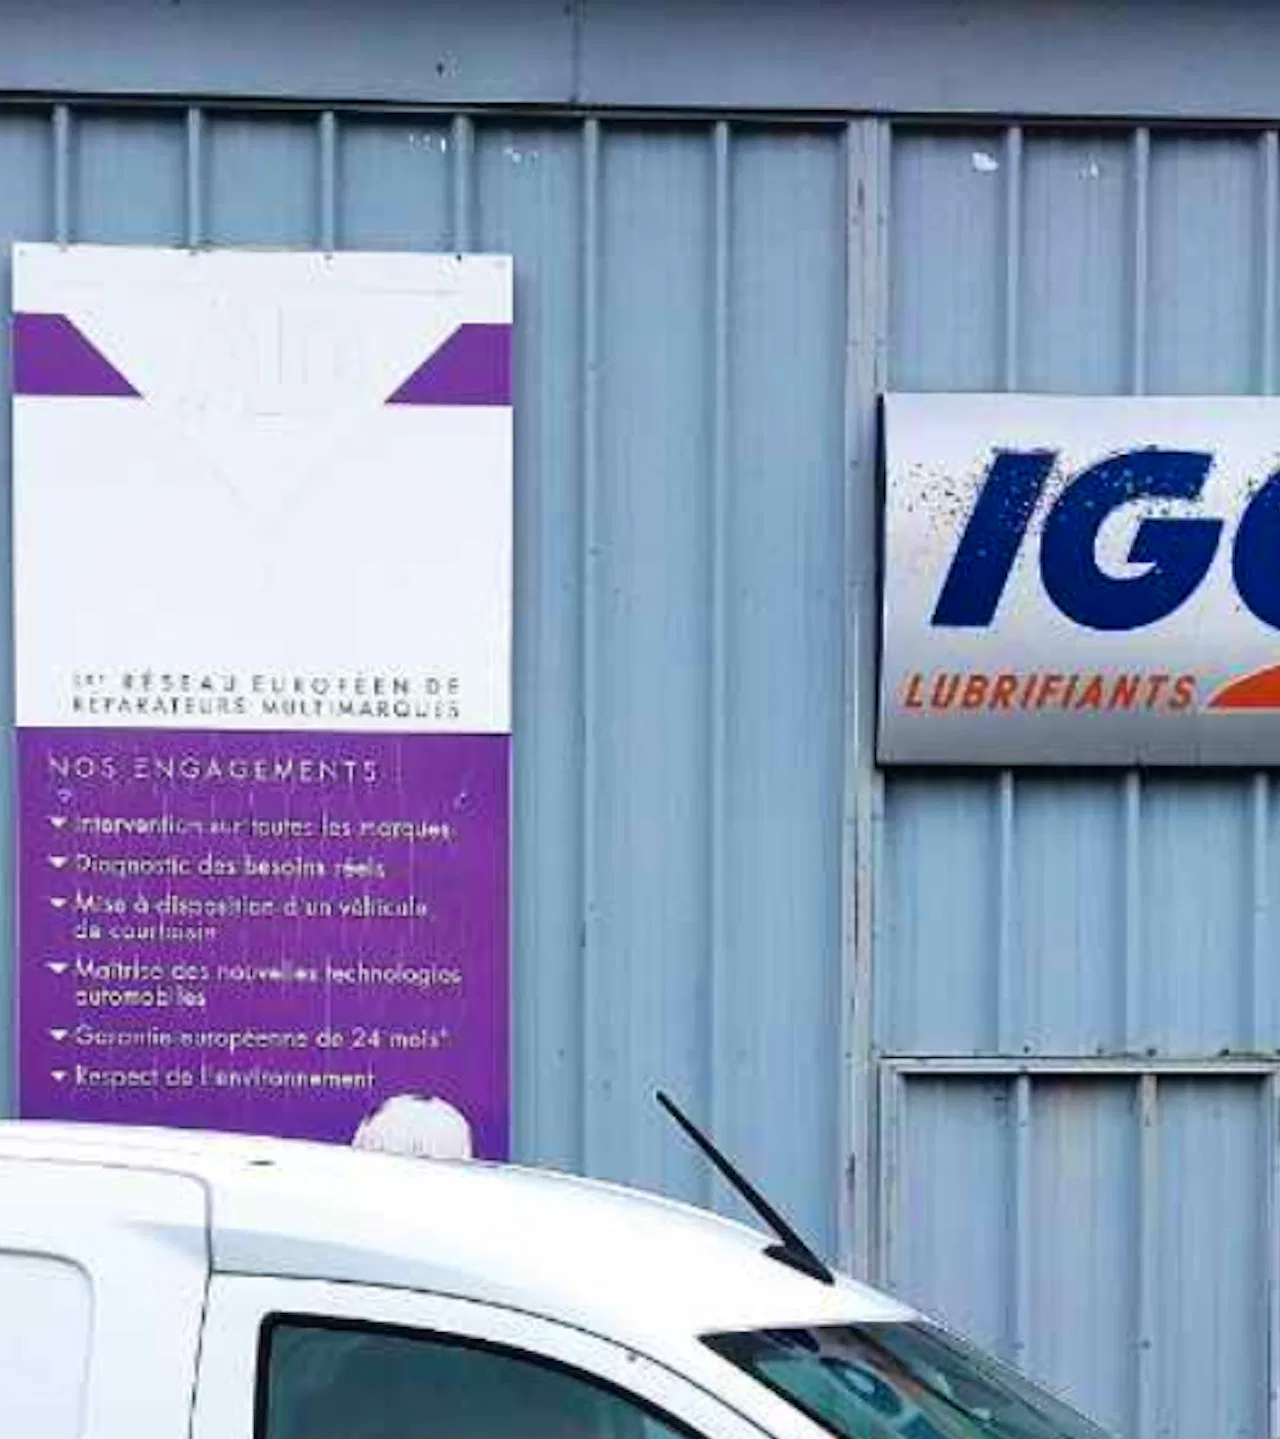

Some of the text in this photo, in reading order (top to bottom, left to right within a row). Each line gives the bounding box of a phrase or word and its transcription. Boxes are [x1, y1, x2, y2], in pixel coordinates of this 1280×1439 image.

[426, 677, 460, 696] DE
[903, 672, 1197, 710] LUBRIFIANTS
[262, 699, 460, 718] MULTIMARQUES
[50, 756, 378, 783] NOS ENGAGEMENTS
[76, 853, 192, 878] Diagnostic
[198, 853, 237, 876] des
[245, 855, 325, 878] besoins
[76, 892, 126, 914] Mise
[326, 961, 463, 988] technologies
[315, 1028, 344, 1049] de
[350, 1027, 380, 1049] 24
[76, 1064, 159, 1089] Respect
[166, 1067, 194, 1087] de
